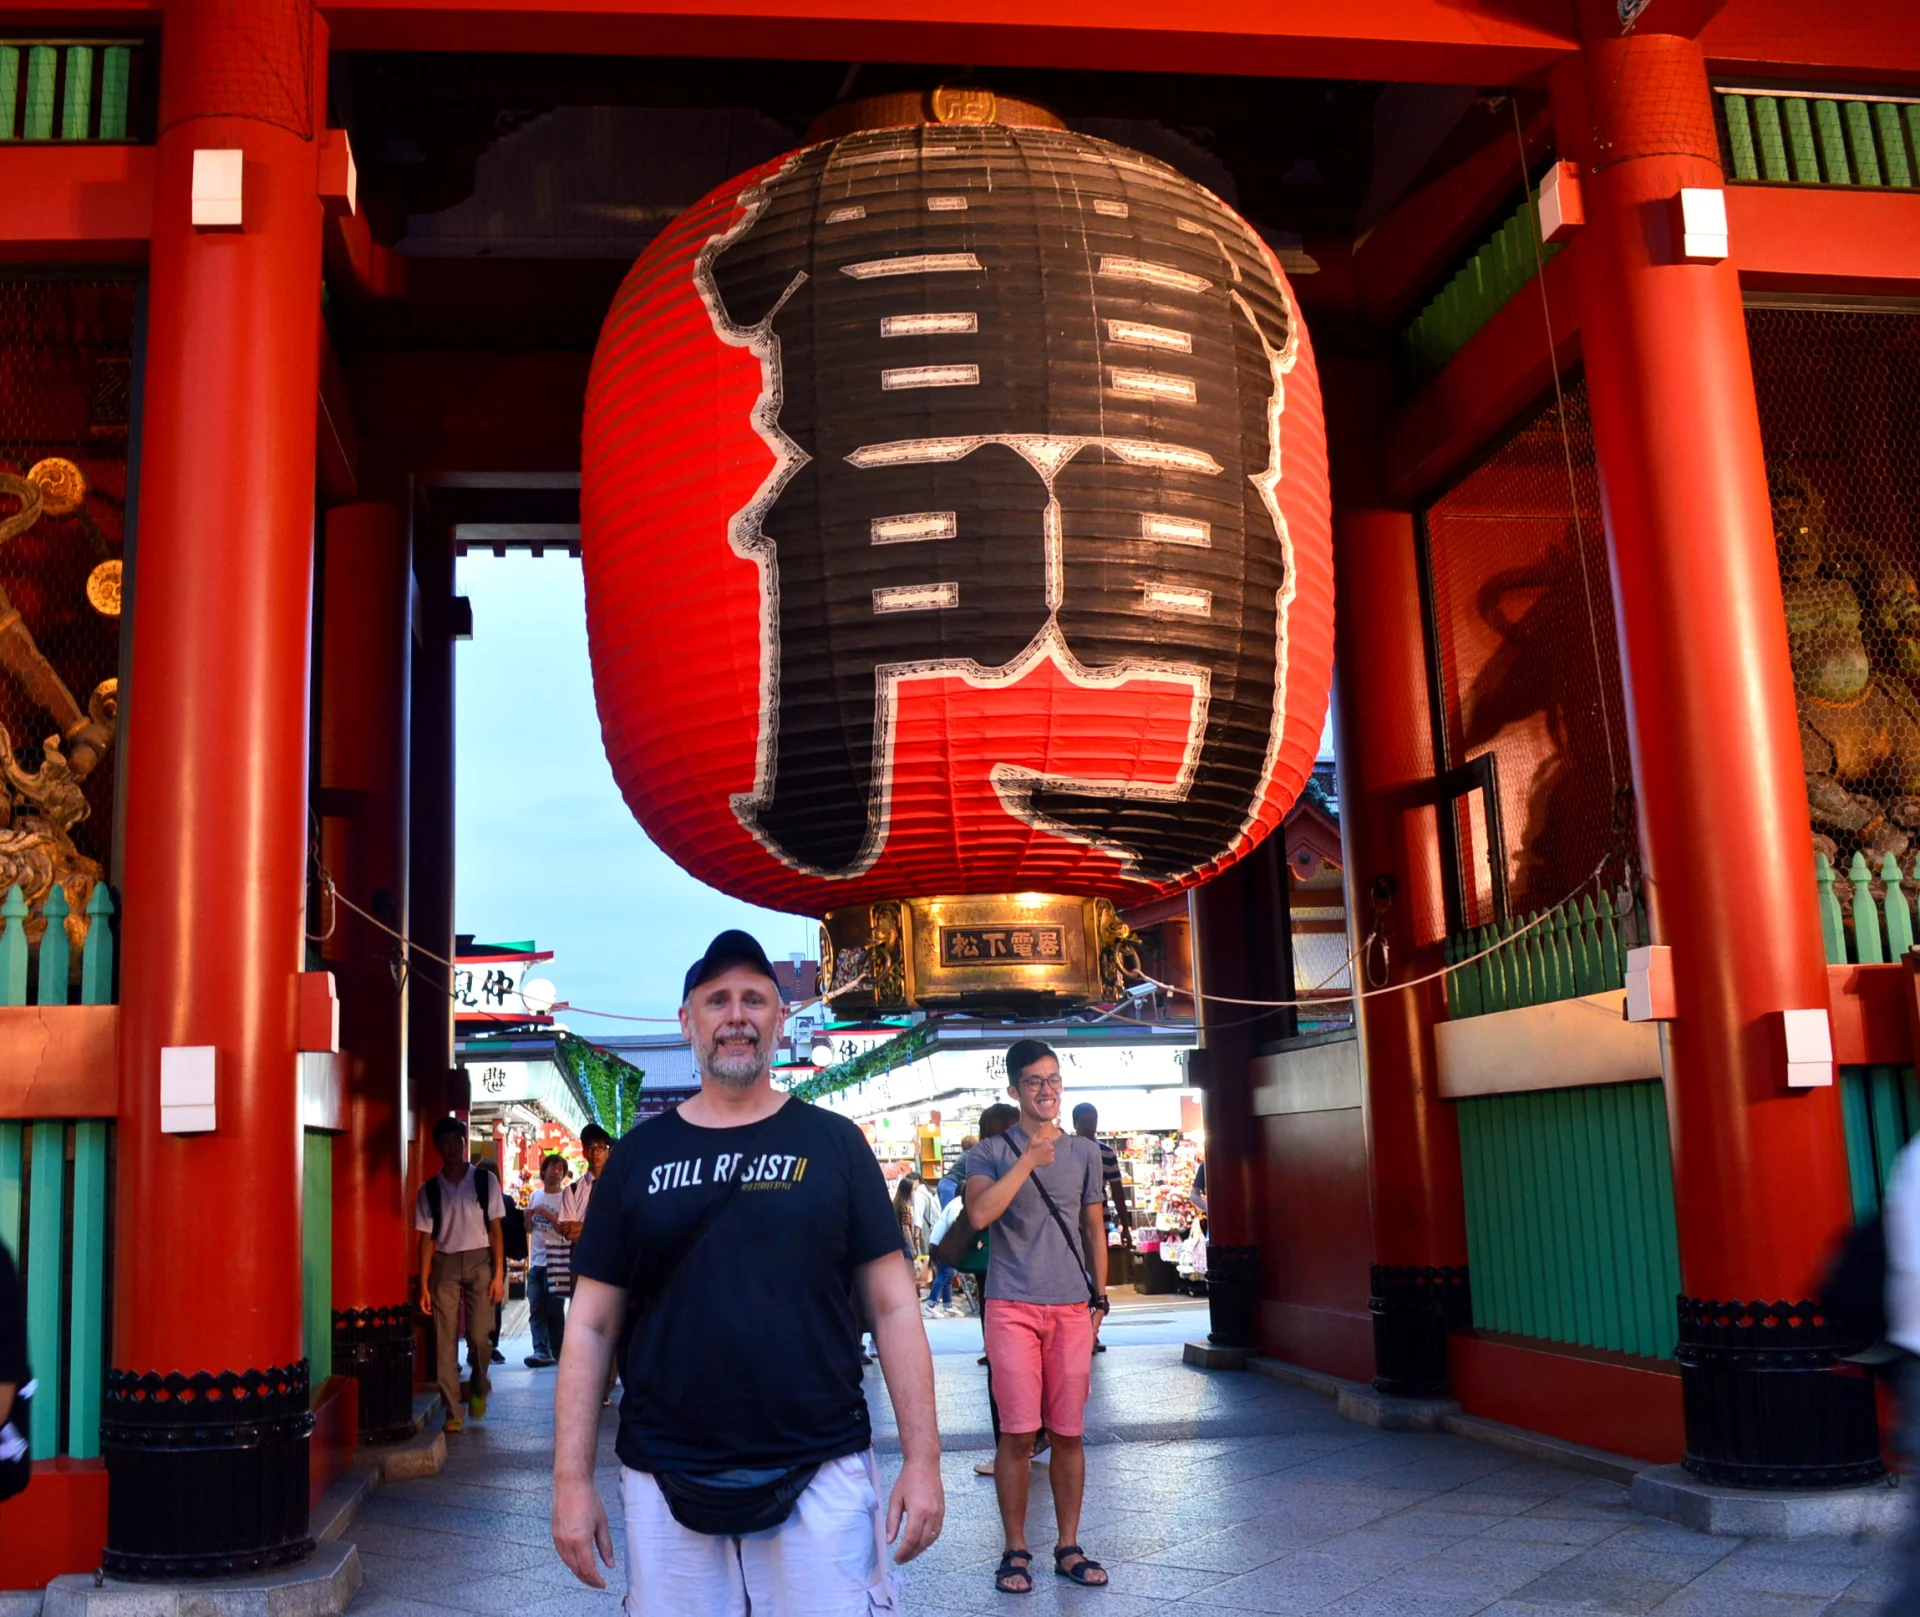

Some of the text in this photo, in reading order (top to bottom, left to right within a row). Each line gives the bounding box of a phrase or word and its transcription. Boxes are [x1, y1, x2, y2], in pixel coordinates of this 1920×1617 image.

[692, 125, 1298, 882] 雷門
[951, 932, 1059, 958] 松下電器
[648, 1158, 702, 1194] STILL
